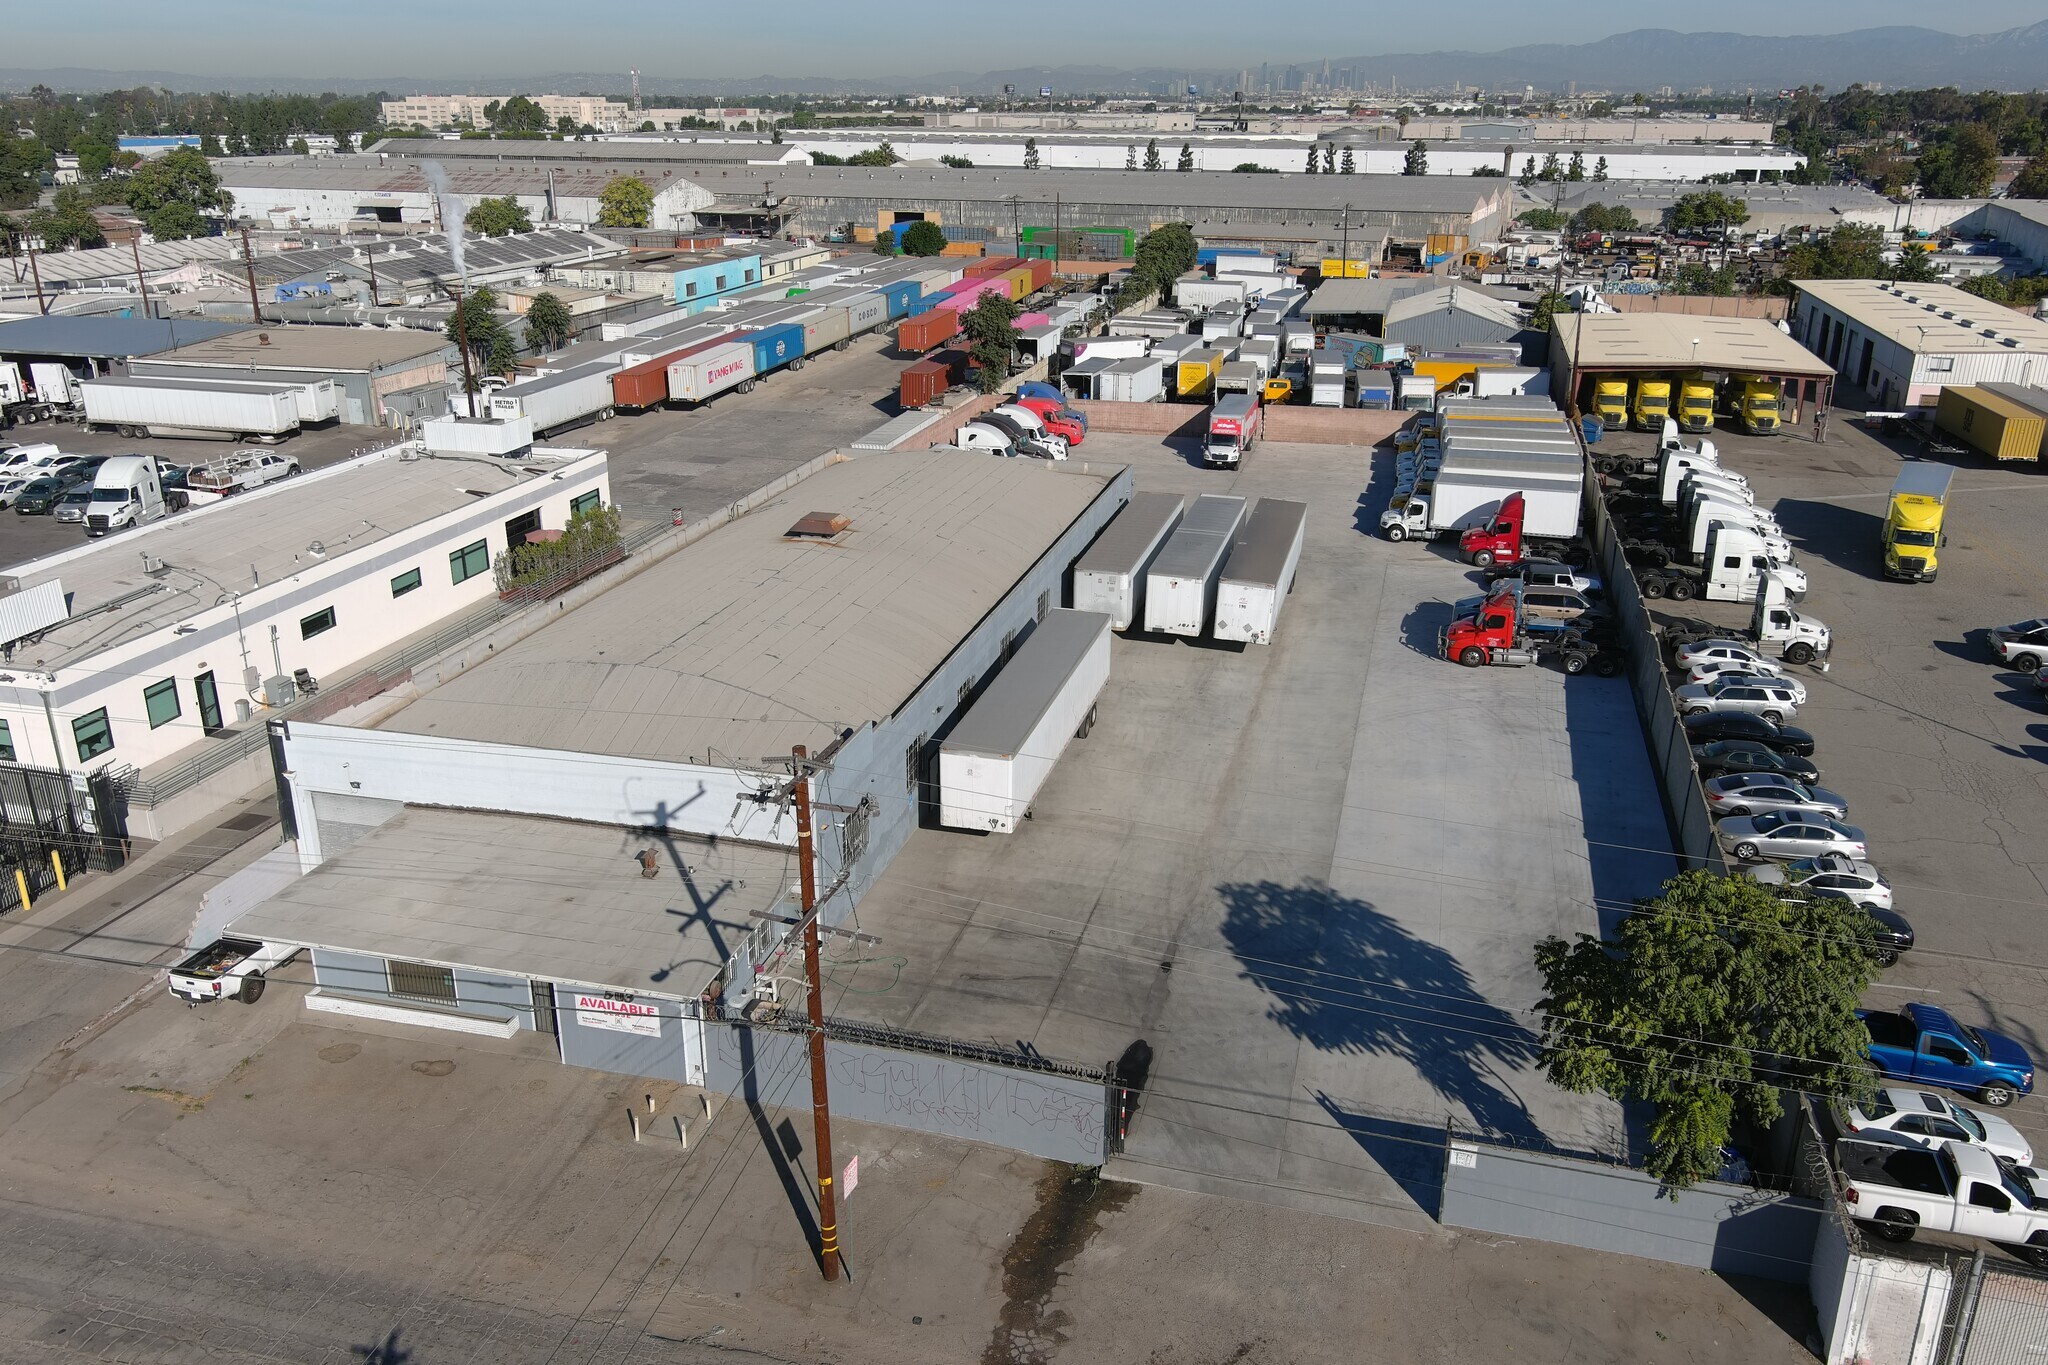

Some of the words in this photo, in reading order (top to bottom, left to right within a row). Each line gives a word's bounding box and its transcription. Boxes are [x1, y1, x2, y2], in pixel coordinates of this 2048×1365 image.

[858, 307, 878, 321] COSCO
[714, 365, 729, 380] YANG
[729, 359, 743, 374] MING
[580, 996, 655, 1016] AVAILABLE
